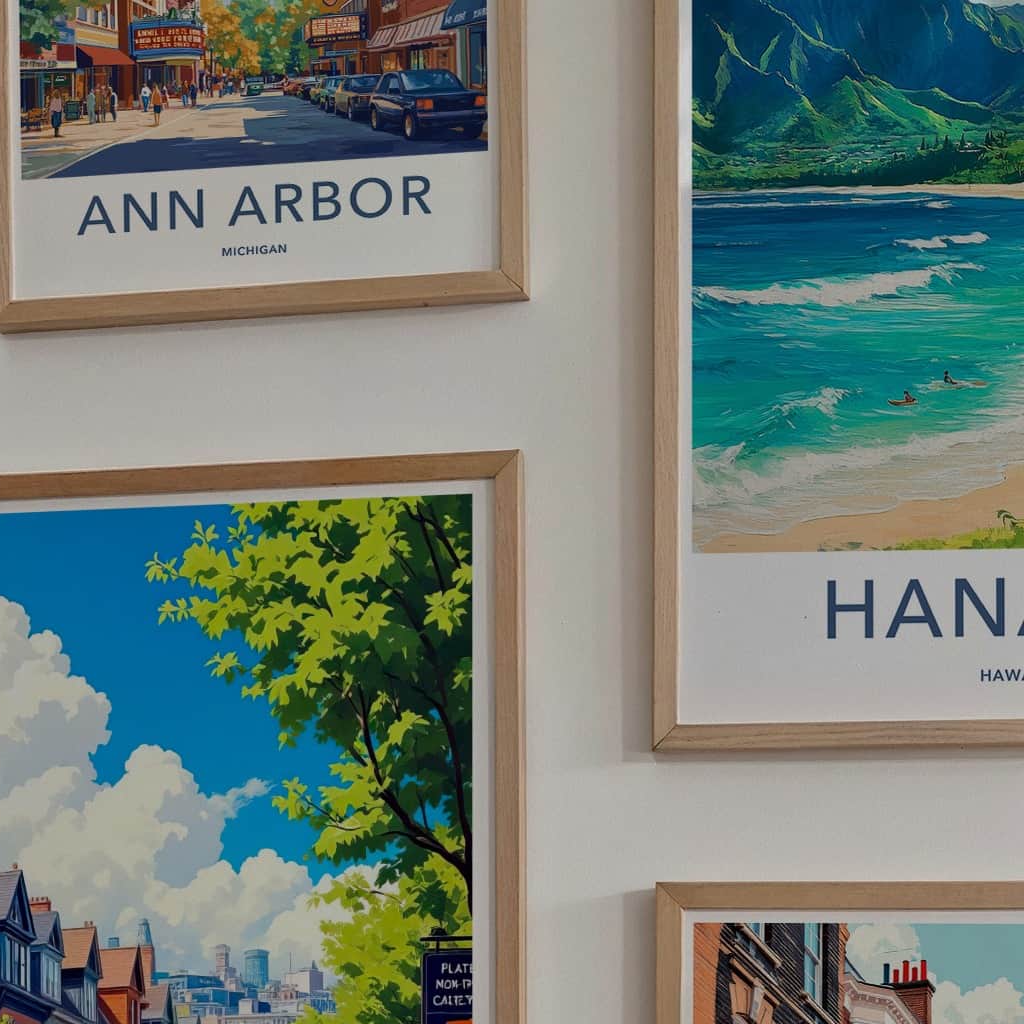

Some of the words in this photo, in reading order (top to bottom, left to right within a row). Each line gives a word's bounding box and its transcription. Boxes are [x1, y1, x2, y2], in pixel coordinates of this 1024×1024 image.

[77, 188, 204, 236] ANN
[228, 175, 432, 227] ARBOR
[221, 243, 287, 257] MICHIGAN
[826, 577, 1024, 639] HAN
[980, 668, 1024, 682] HAW
